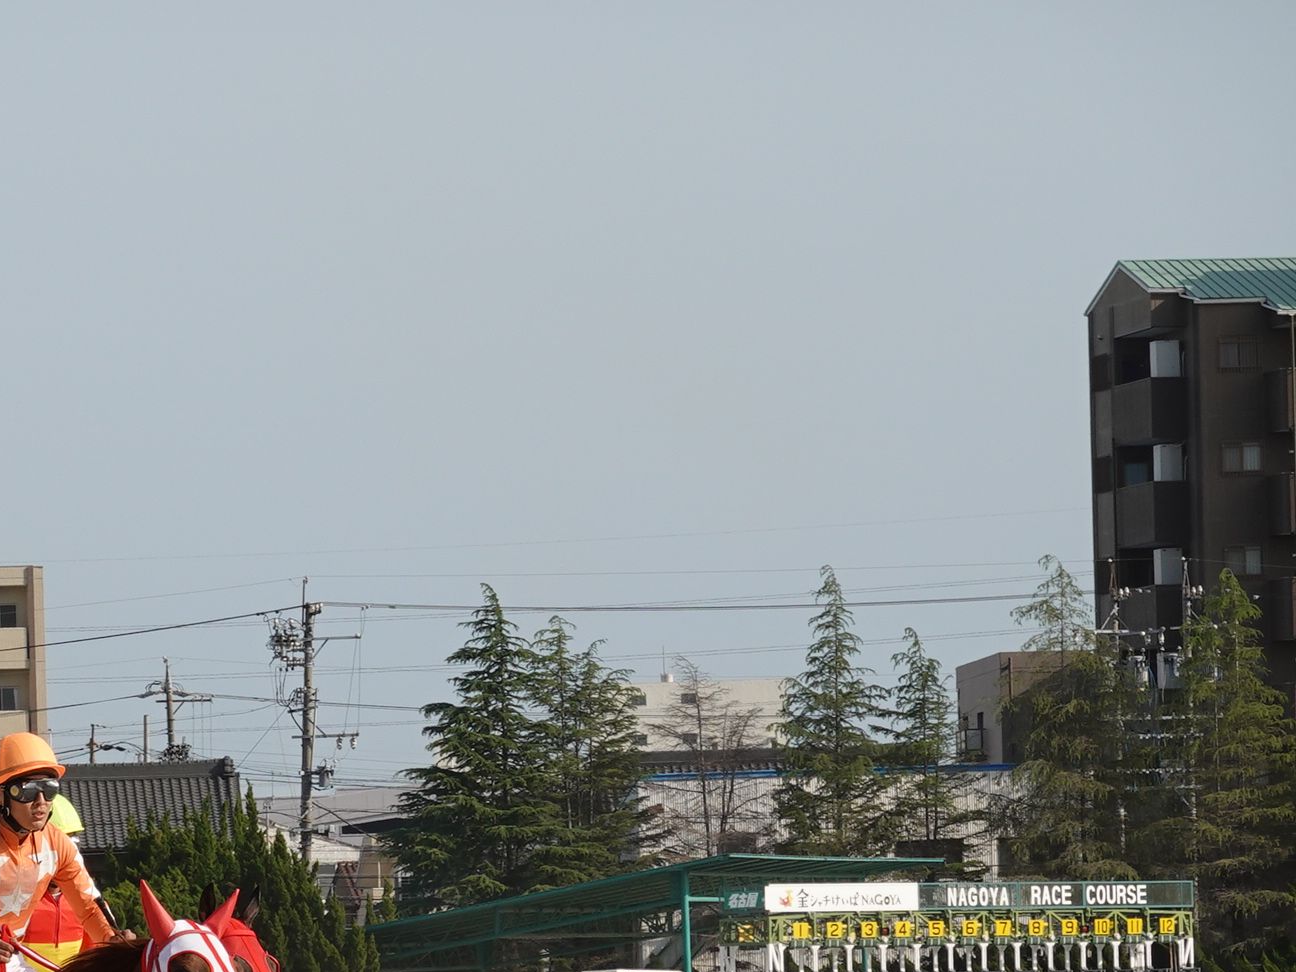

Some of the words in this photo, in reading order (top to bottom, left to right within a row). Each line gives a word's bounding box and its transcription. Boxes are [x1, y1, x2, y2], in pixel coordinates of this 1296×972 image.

[947, 887, 1010, 907] NAGOYA
[1030, 885, 1072, 905] RACE
[1086, 884, 1148, 905] COURSE
[830, 924, 839, 937] 2
[864, 923, 874, 935] 3
[898, 922, 907, 935] 4
[931, 923, 941, 936] 5
[964, 922, 974, 935] 6
[1000, 922, 1008, 935] 7
[1032, 921, 1041, 934] 8
[1065, 920, 1076, 934] 9
[1095, 920, 1109, 934] 10
[1129, 920, 1141, 933] 11
[1162, 919, 1174, 933] 12
